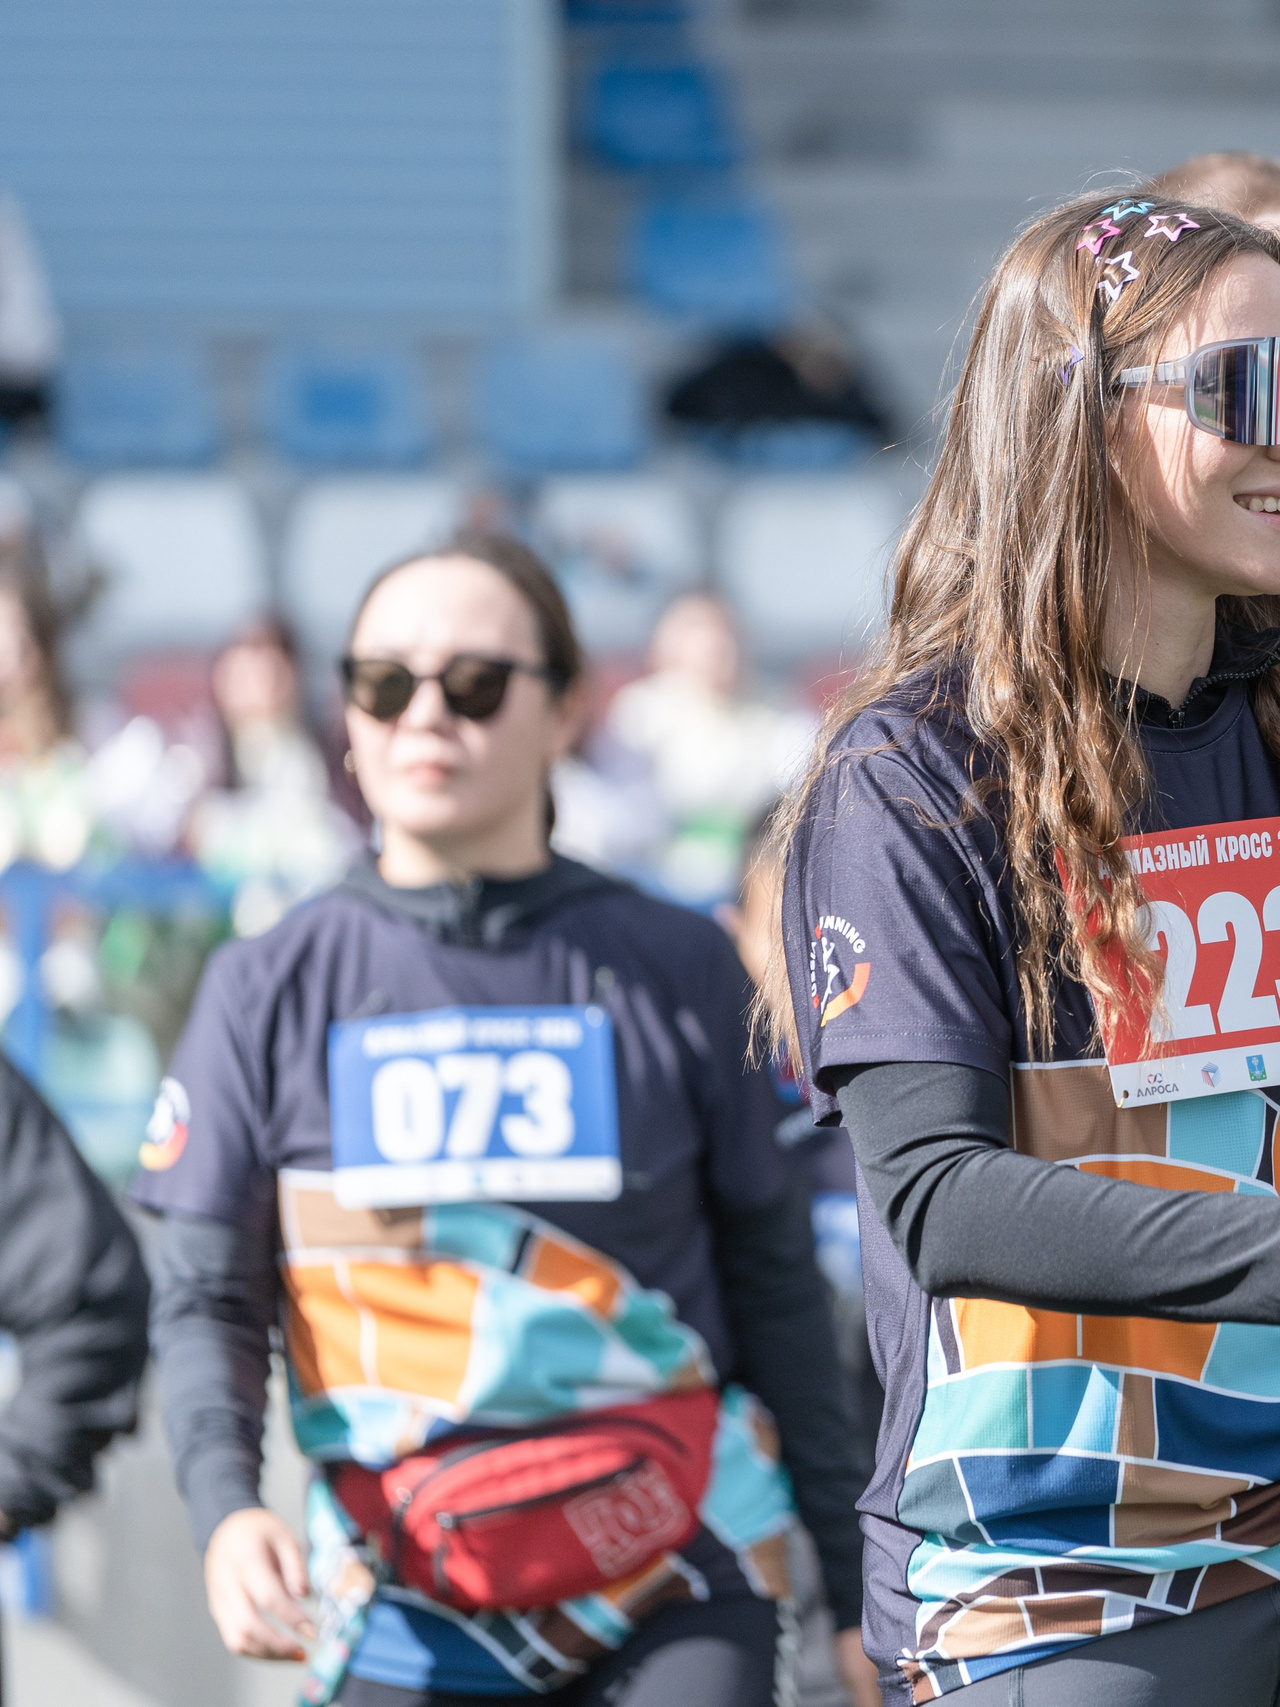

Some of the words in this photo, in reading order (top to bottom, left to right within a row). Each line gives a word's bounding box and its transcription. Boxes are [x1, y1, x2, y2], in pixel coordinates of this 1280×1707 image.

[1098, 834, 1210, 880] АМАЗНЫЙ
[1215, 831, 1272, 863] КРОСС
[371, 1050, 575, 1164] 073
